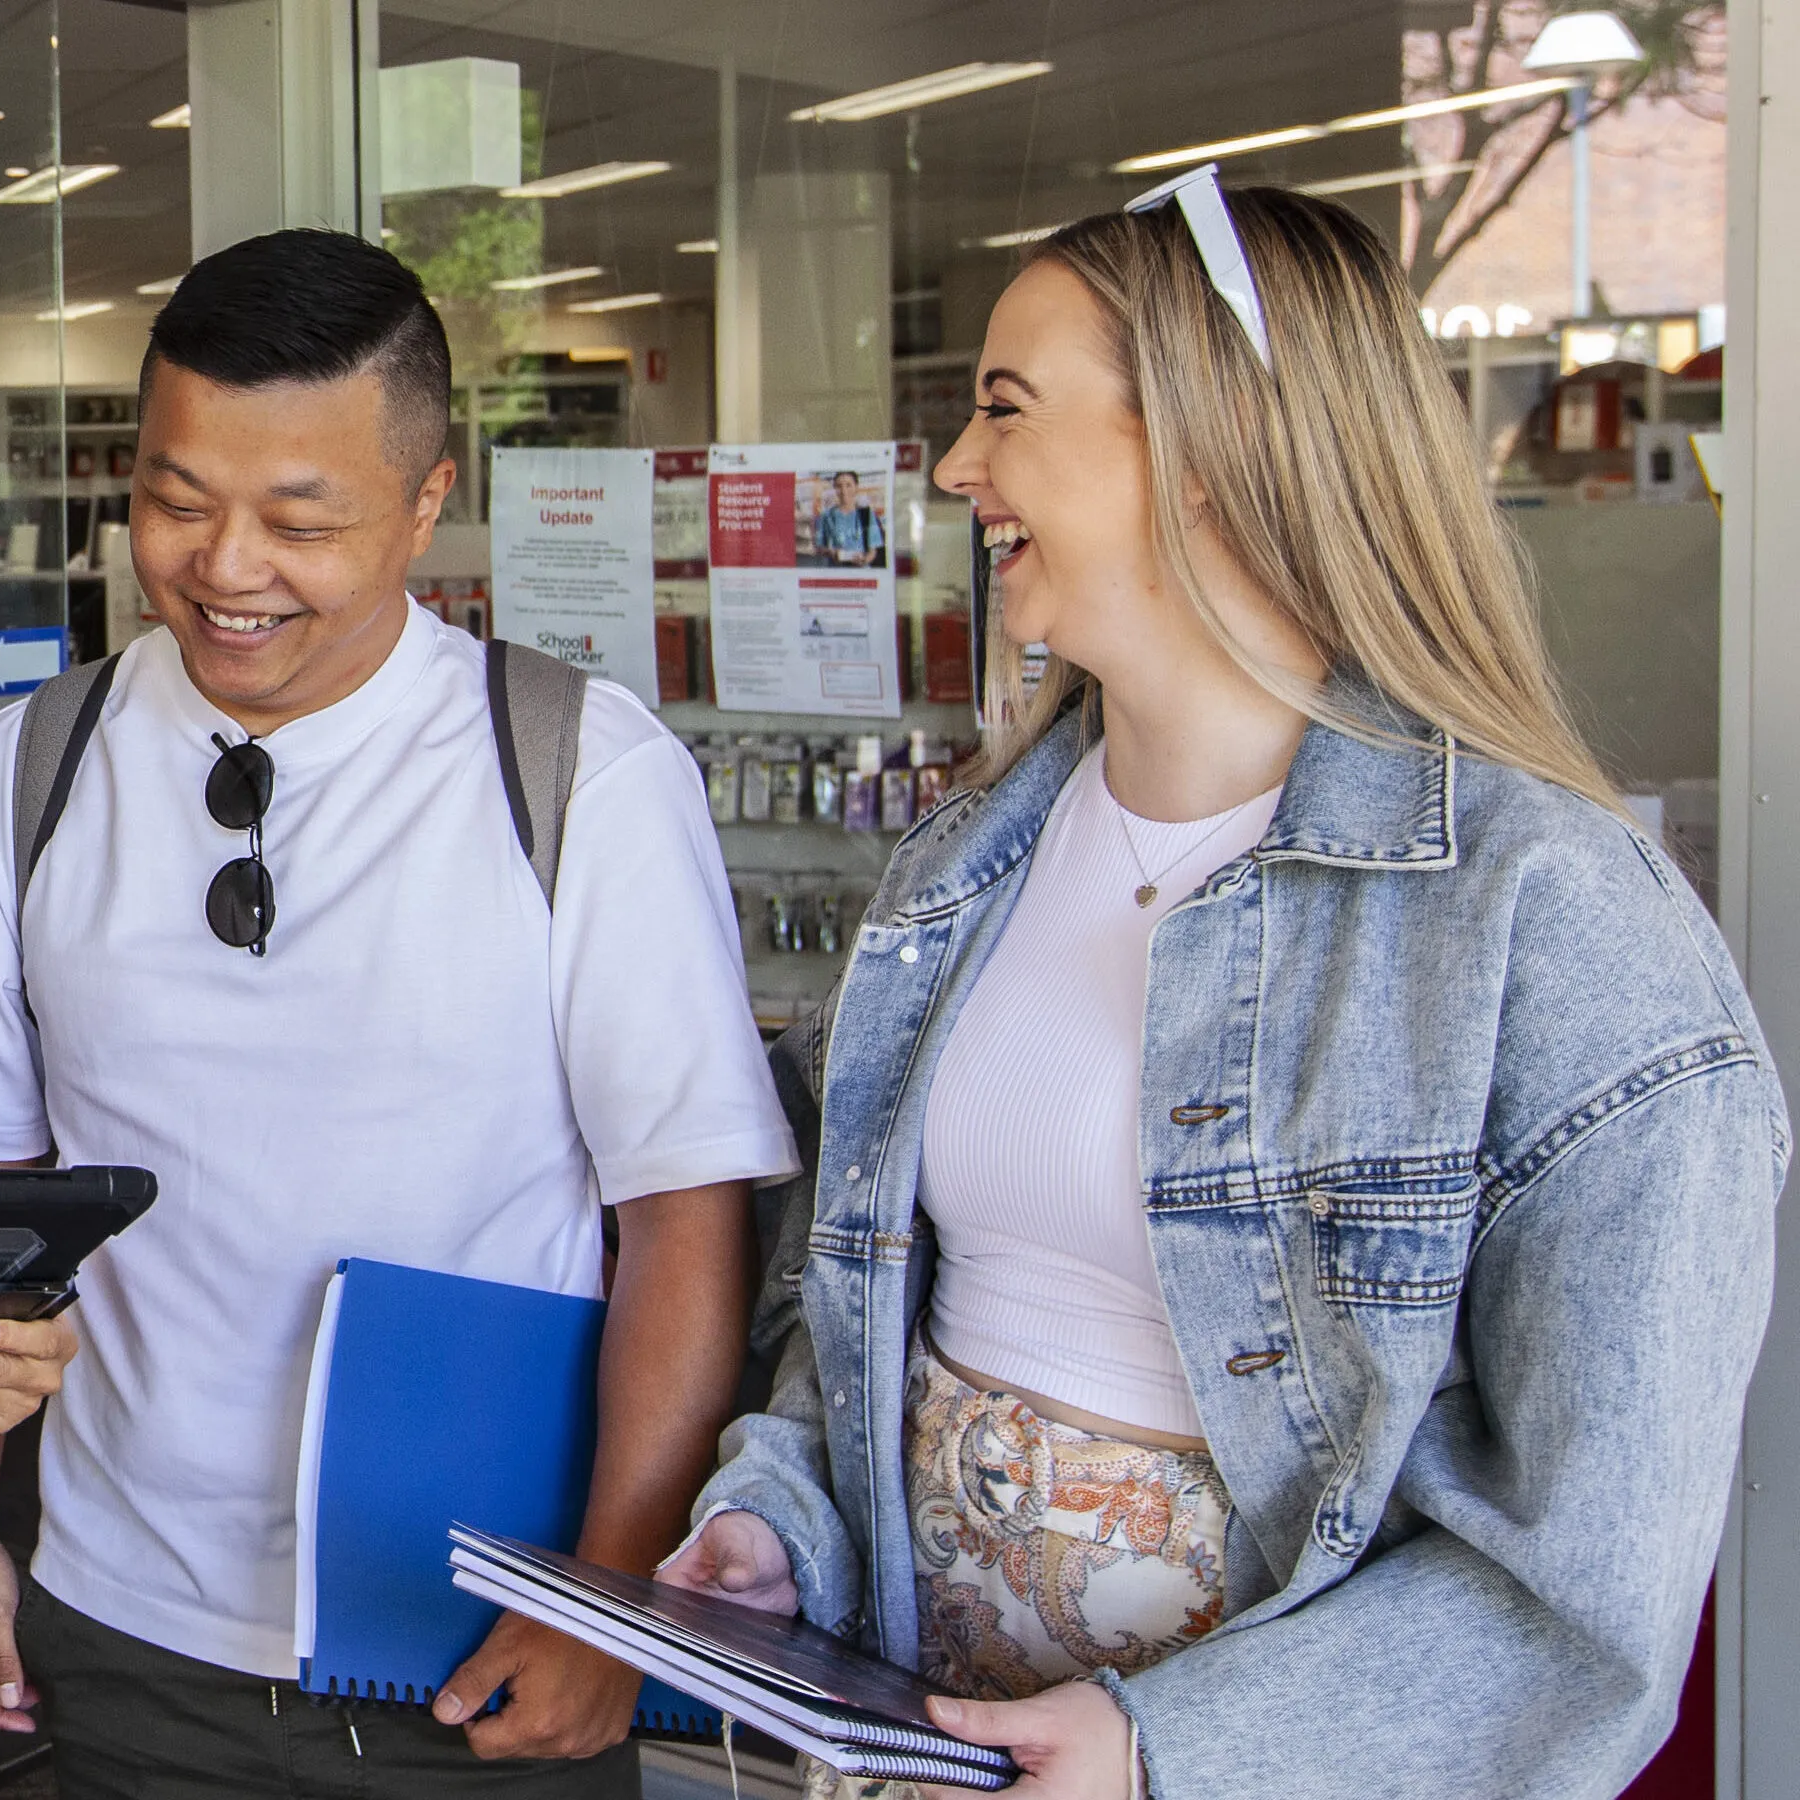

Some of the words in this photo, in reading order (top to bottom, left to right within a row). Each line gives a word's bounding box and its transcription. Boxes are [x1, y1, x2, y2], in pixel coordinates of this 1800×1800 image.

[531, 486, 605, 503] Important
[717, 482, 764, 494] Student
[717, 495, 771, 507] Resource
[539, 509, 594, 527] Update
[717, 507, 764, 520] Request
[718, 519, 762, 531] Process
[537, 632, 584, 650] School
[559, 643, 604, 664] Locker
